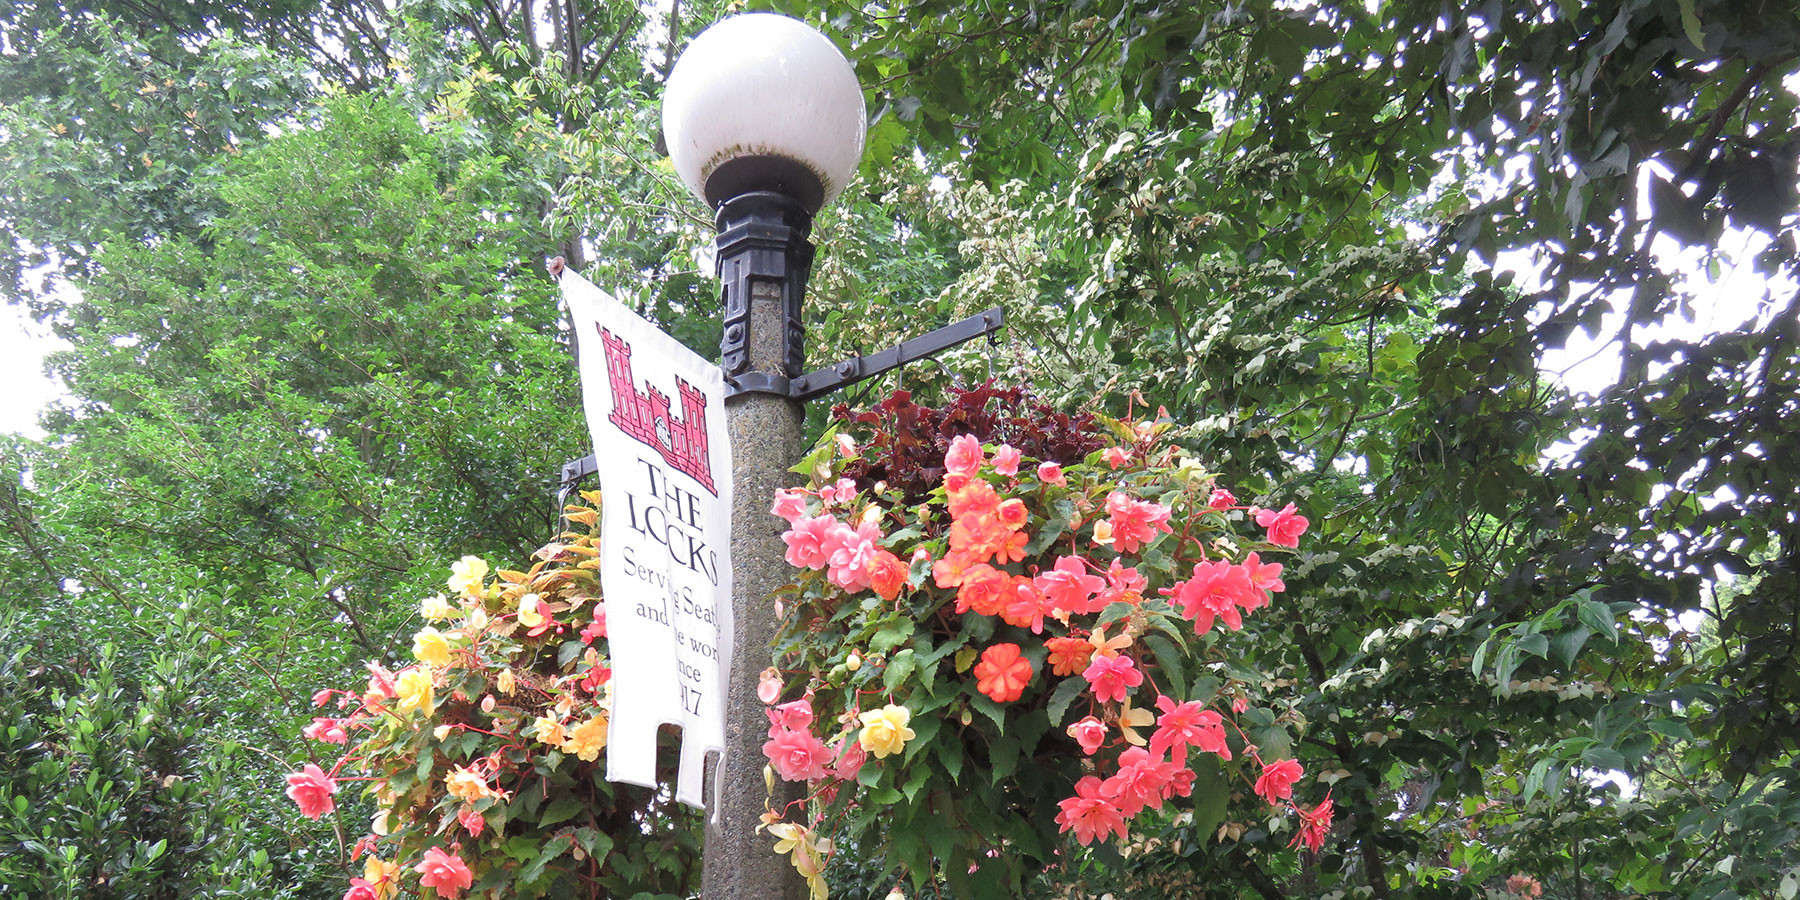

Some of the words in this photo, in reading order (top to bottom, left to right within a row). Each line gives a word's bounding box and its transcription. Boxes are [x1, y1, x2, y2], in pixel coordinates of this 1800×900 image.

[637, 457, 703, 532] THE
[625, 491, 718, 587] LOCKS
[623, 546, 680, 614] Servig
[636, 598, 670, 627] and
[678, 659, 701, 683] nce
